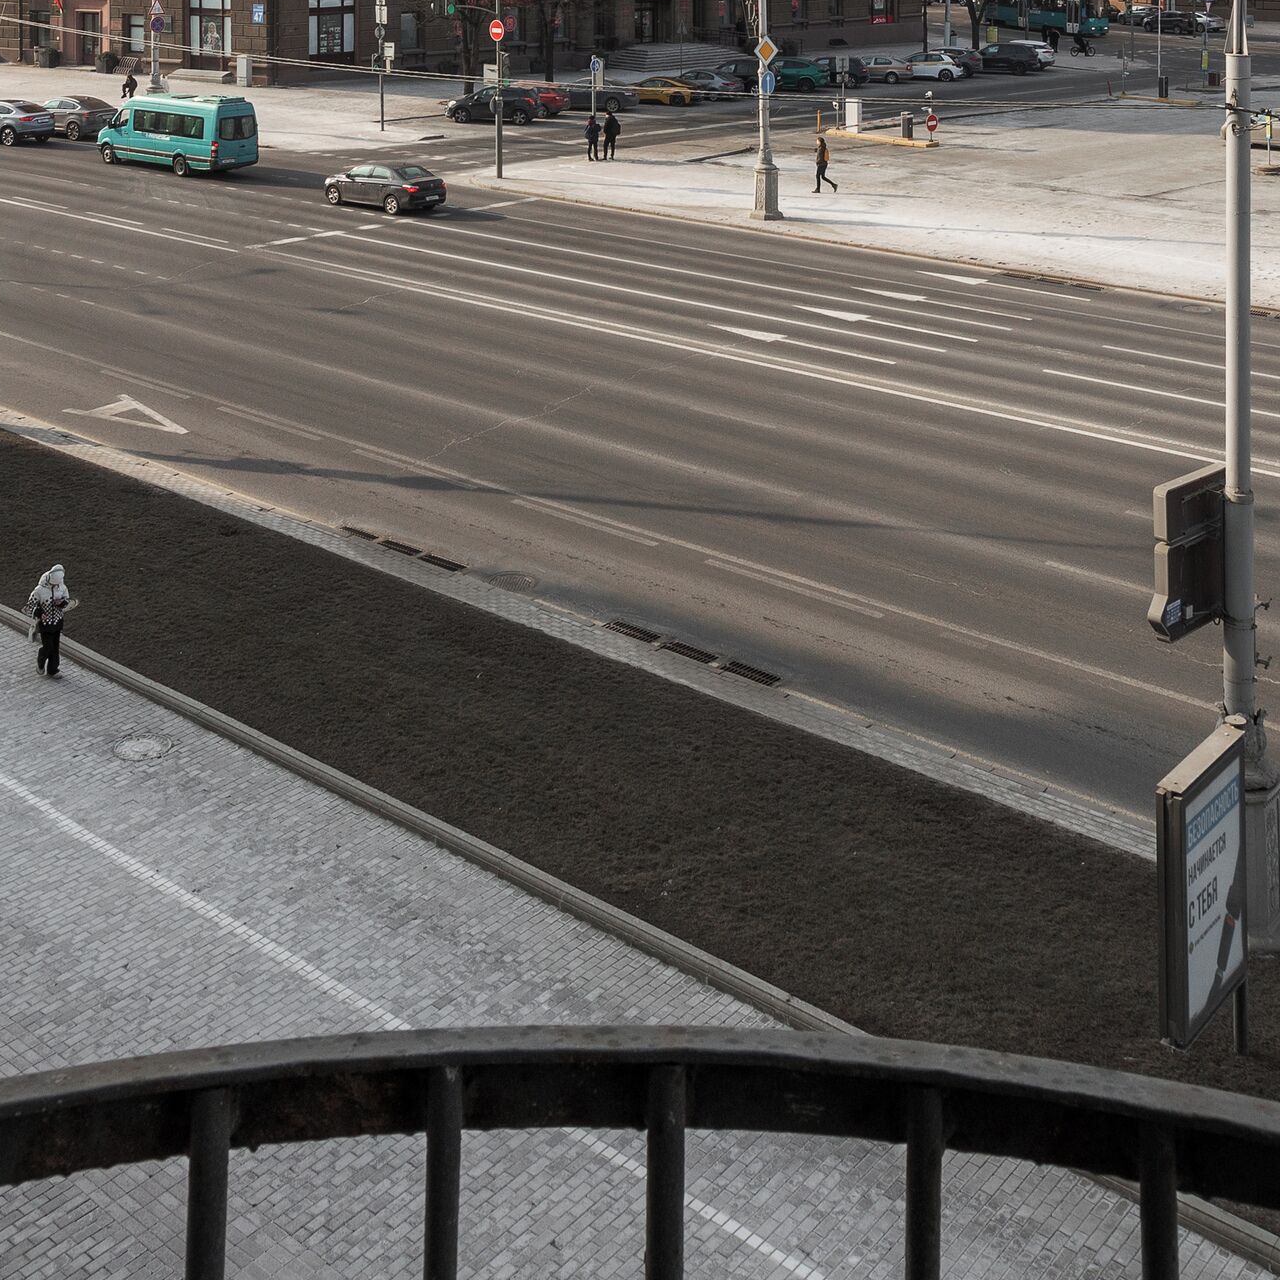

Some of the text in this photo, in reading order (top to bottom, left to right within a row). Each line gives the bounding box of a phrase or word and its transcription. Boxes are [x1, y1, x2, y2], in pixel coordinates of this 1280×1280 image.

[1187, 780, 1239, 847] БЕЗОПАСНОСТЬ
[1188, 831, 1227, 887] НАЧИНАЕТСЯ
[1188, 901, 1195, 929] С
[1196, 875, 1218, 921] ТЕБЯ
